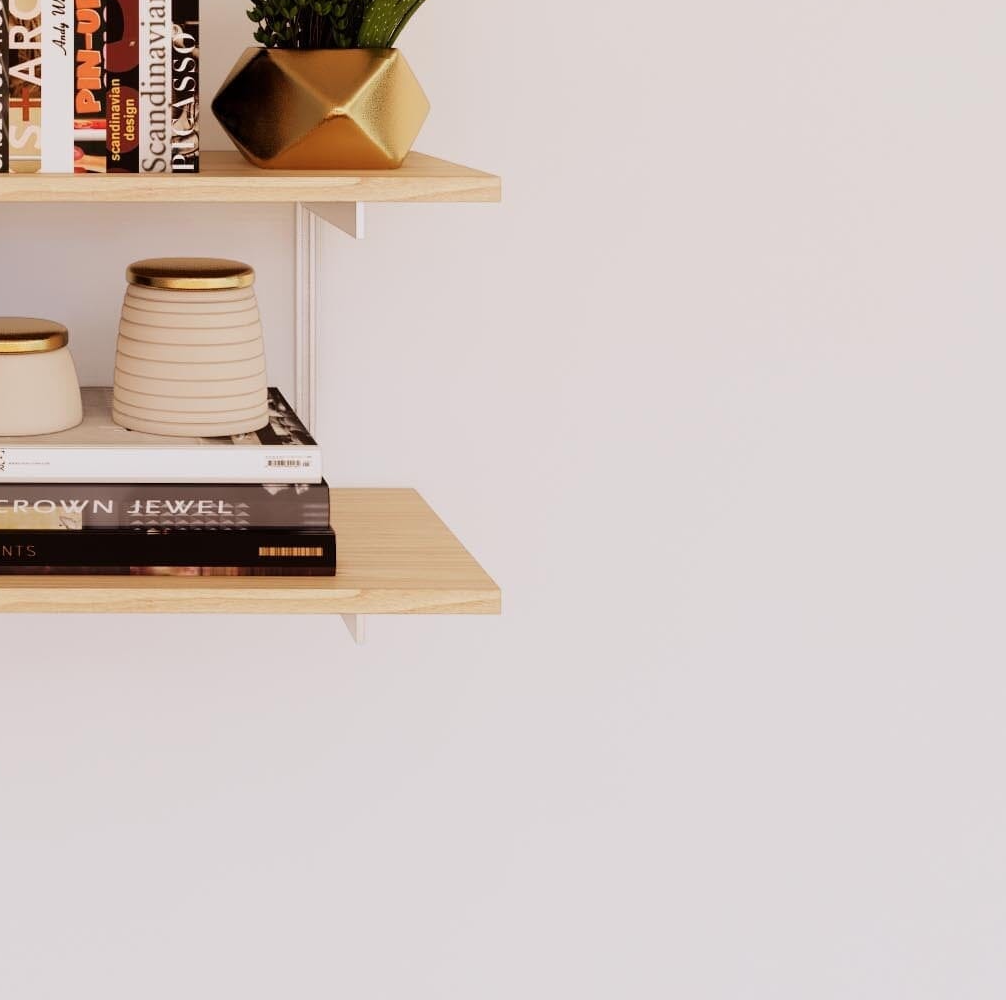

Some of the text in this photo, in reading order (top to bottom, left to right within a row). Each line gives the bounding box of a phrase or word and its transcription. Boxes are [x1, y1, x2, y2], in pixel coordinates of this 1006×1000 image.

[51, 22, 69, 55] Andy
[112, 78, 120, 160] scandinavian
[125, 99, 137, 141] design
[172, 32, 196, 170] PICASSO
[126, 499, 234, 515] JEWEL
